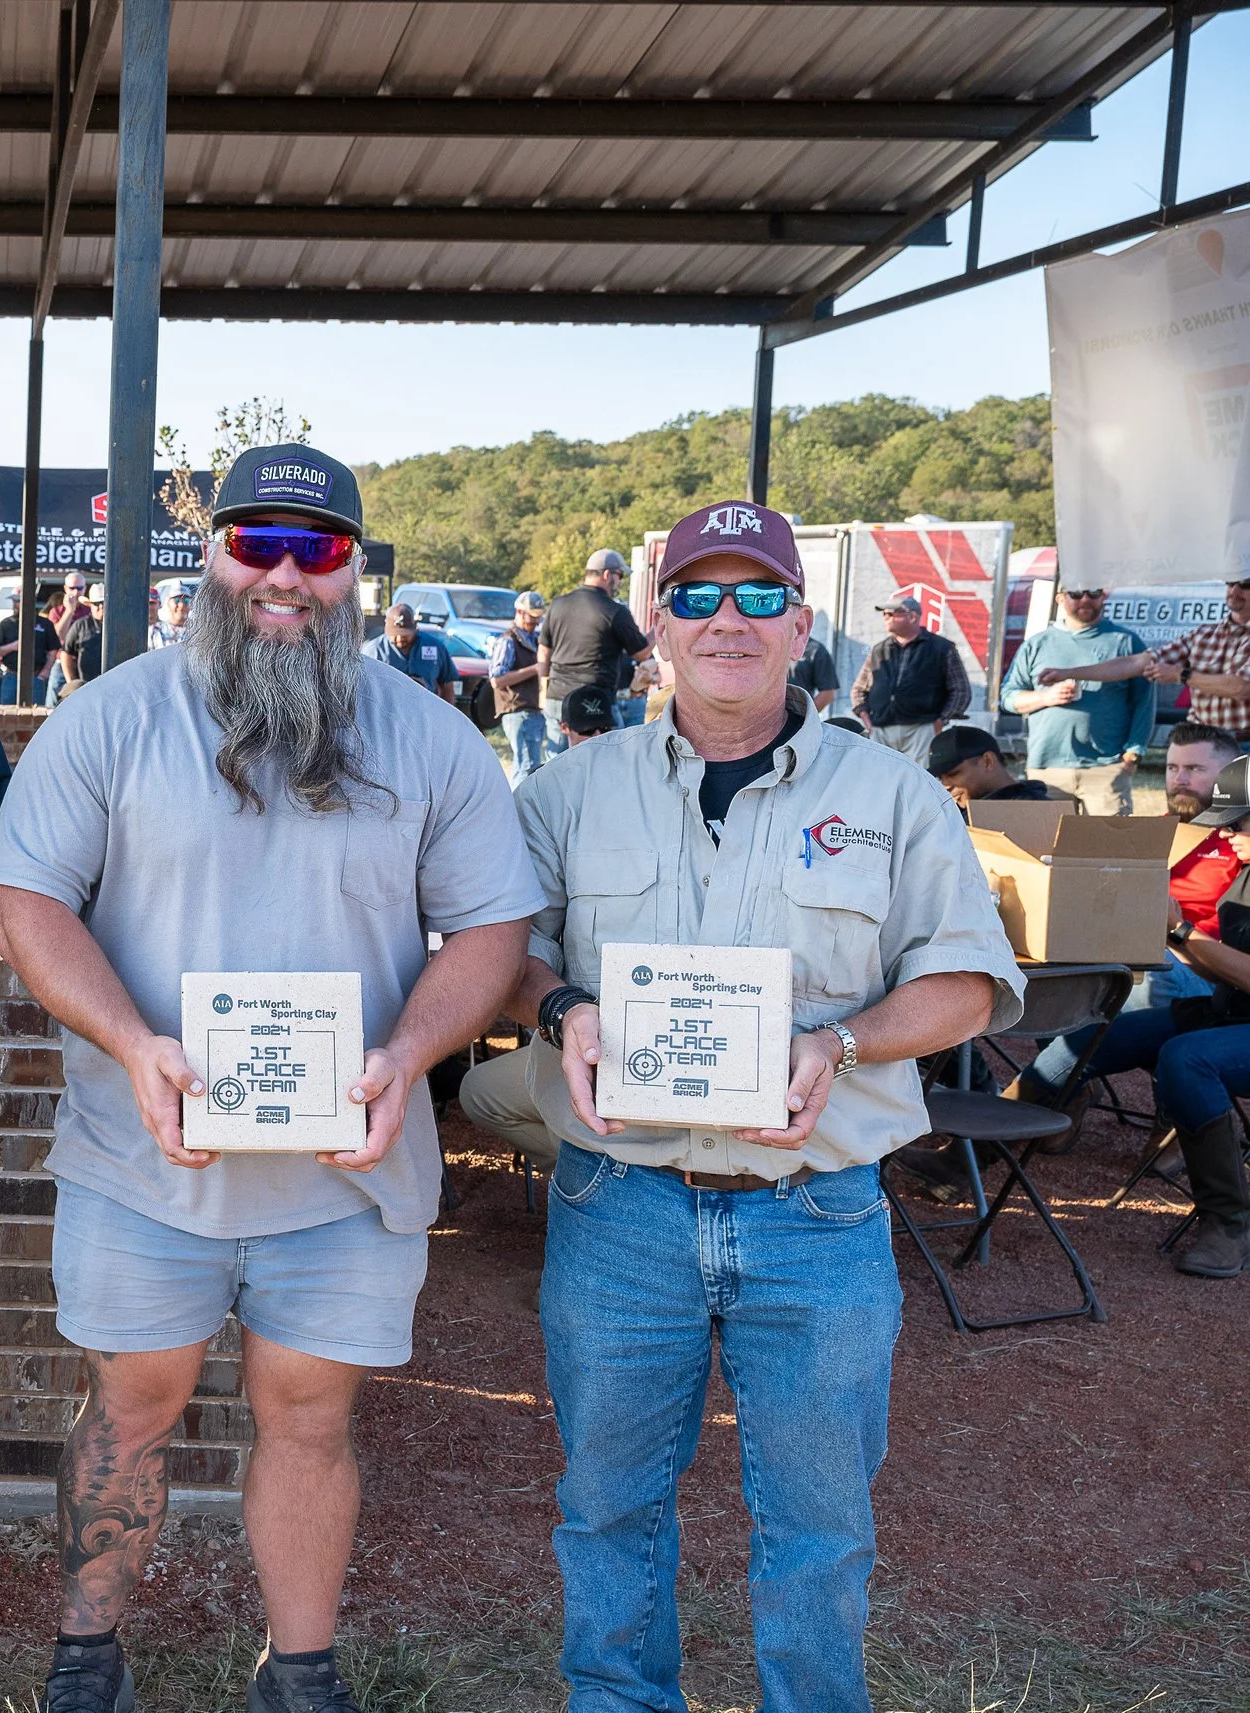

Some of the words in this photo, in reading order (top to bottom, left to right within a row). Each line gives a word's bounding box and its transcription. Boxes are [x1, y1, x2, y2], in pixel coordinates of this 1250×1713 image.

[261, 465, 326, 486] SILVERADO
[258, 486, 293, 494] CONSTRUCTION
[294, 488, 315, 496] SERVICES
[1102, 602, 1148, 621] EELE
[1157, 604, 1169, 620] &
[830, 827, 892, 846] ELEMENTS
[658, 972, 679, 981] Fort
[681, 973, 714, 982] Worth
[692, 983, 737, 994] Sporting
[739, 984, 762, 995] Clay
[238, 1000, 258, 1008] Fort
[260, 1000, 291, 1008] Worth
[671, 998, 712, 1009] 2024
[271, 1009, 313, 1020] Sporting
[315, 1010, 337, 1020] Clay
[251, 1025, 290, 1035] 2024
[670, 1019, 713, 1033] 1ST
[655, 1035, 727, 1051] PLACE
[251, 1047, 291, 1060] 1ST
[664, 1052, 717, 1066] TEAM
[237, 1063, 305, 1077] PLACE
[247, 1080, 296, 1092] TEAM
[673, 1083, 703, 1091] ACME
